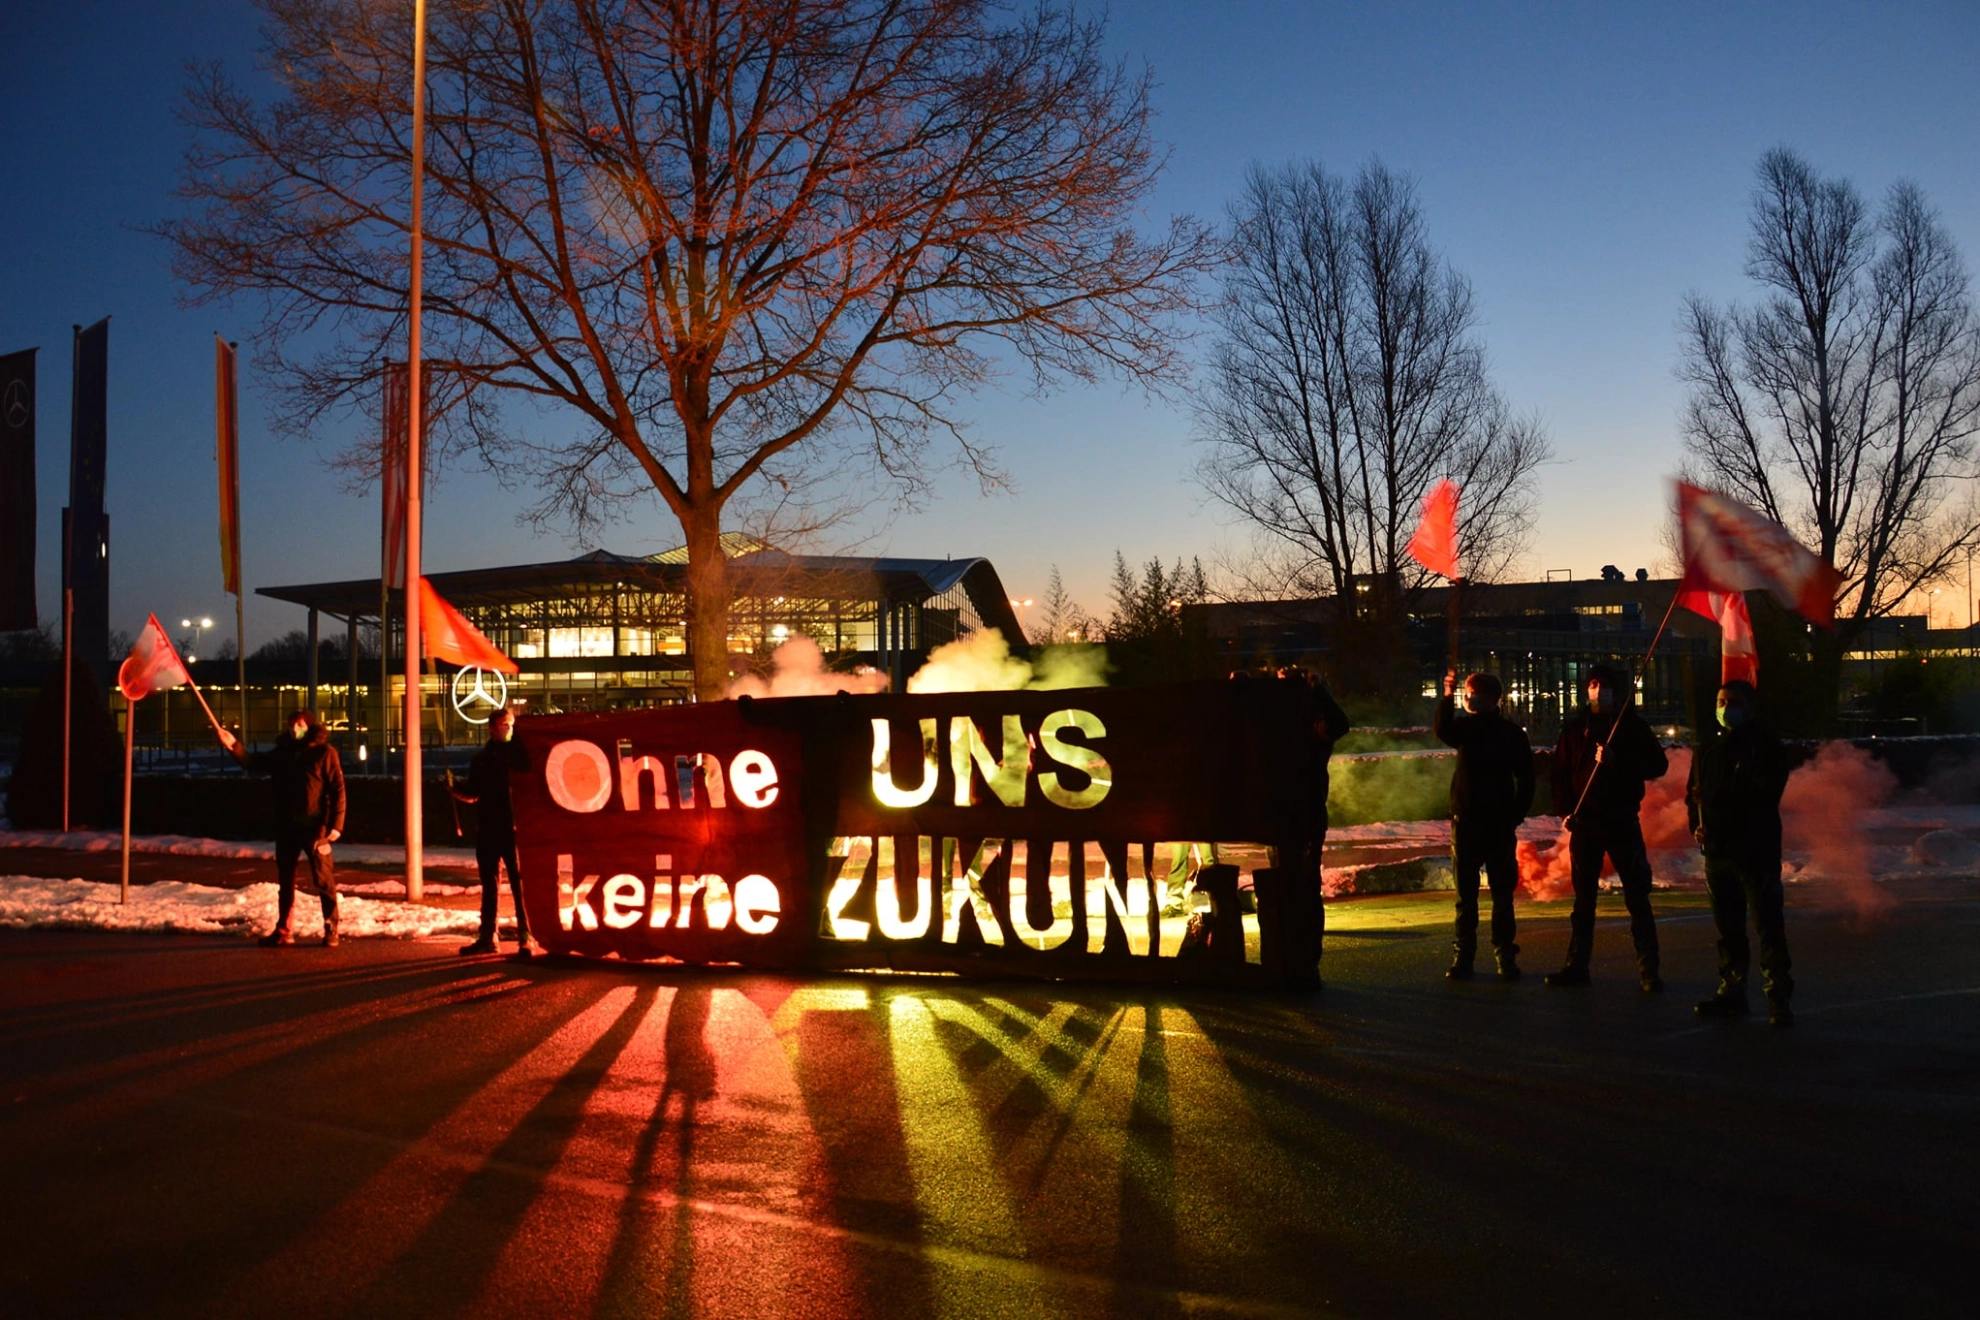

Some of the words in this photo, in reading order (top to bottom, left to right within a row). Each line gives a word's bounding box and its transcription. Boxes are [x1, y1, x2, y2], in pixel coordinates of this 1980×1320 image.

[546, 739, 779, 813] Ohne
[871, 709, 1112, 810] UNS
[557, 854, 781, 934] keine
